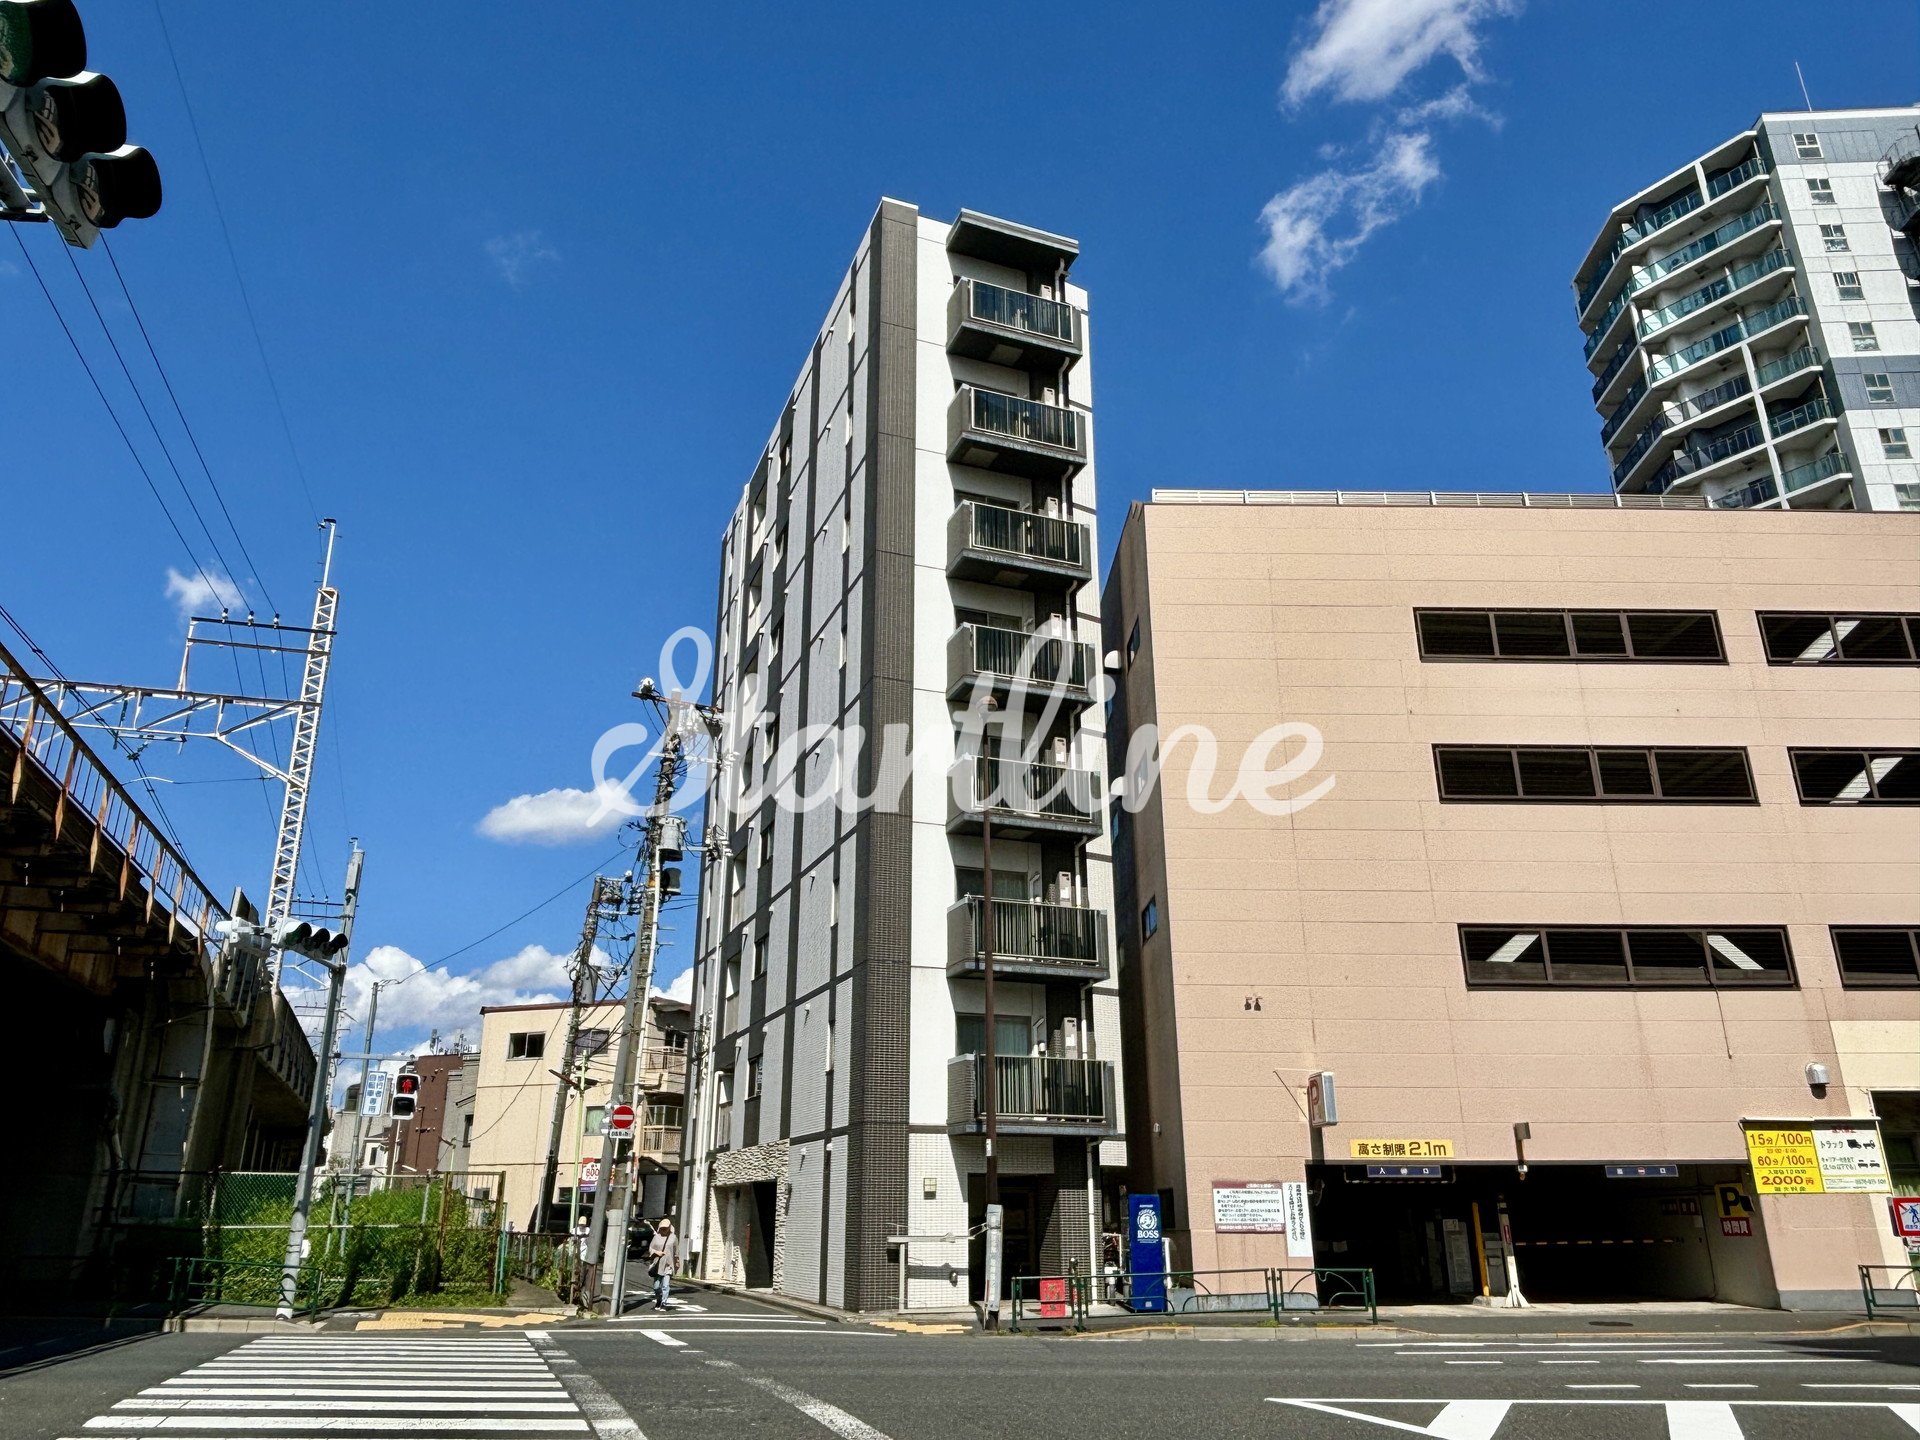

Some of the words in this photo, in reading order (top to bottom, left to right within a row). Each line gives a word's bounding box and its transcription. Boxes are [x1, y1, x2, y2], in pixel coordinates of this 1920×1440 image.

[1750, 1133, 1812, 1146] 15分/100円
[1757, 1155, 1813, 1166] 60分/100円
[1137, 1230, 1159, 1239] BOSS
